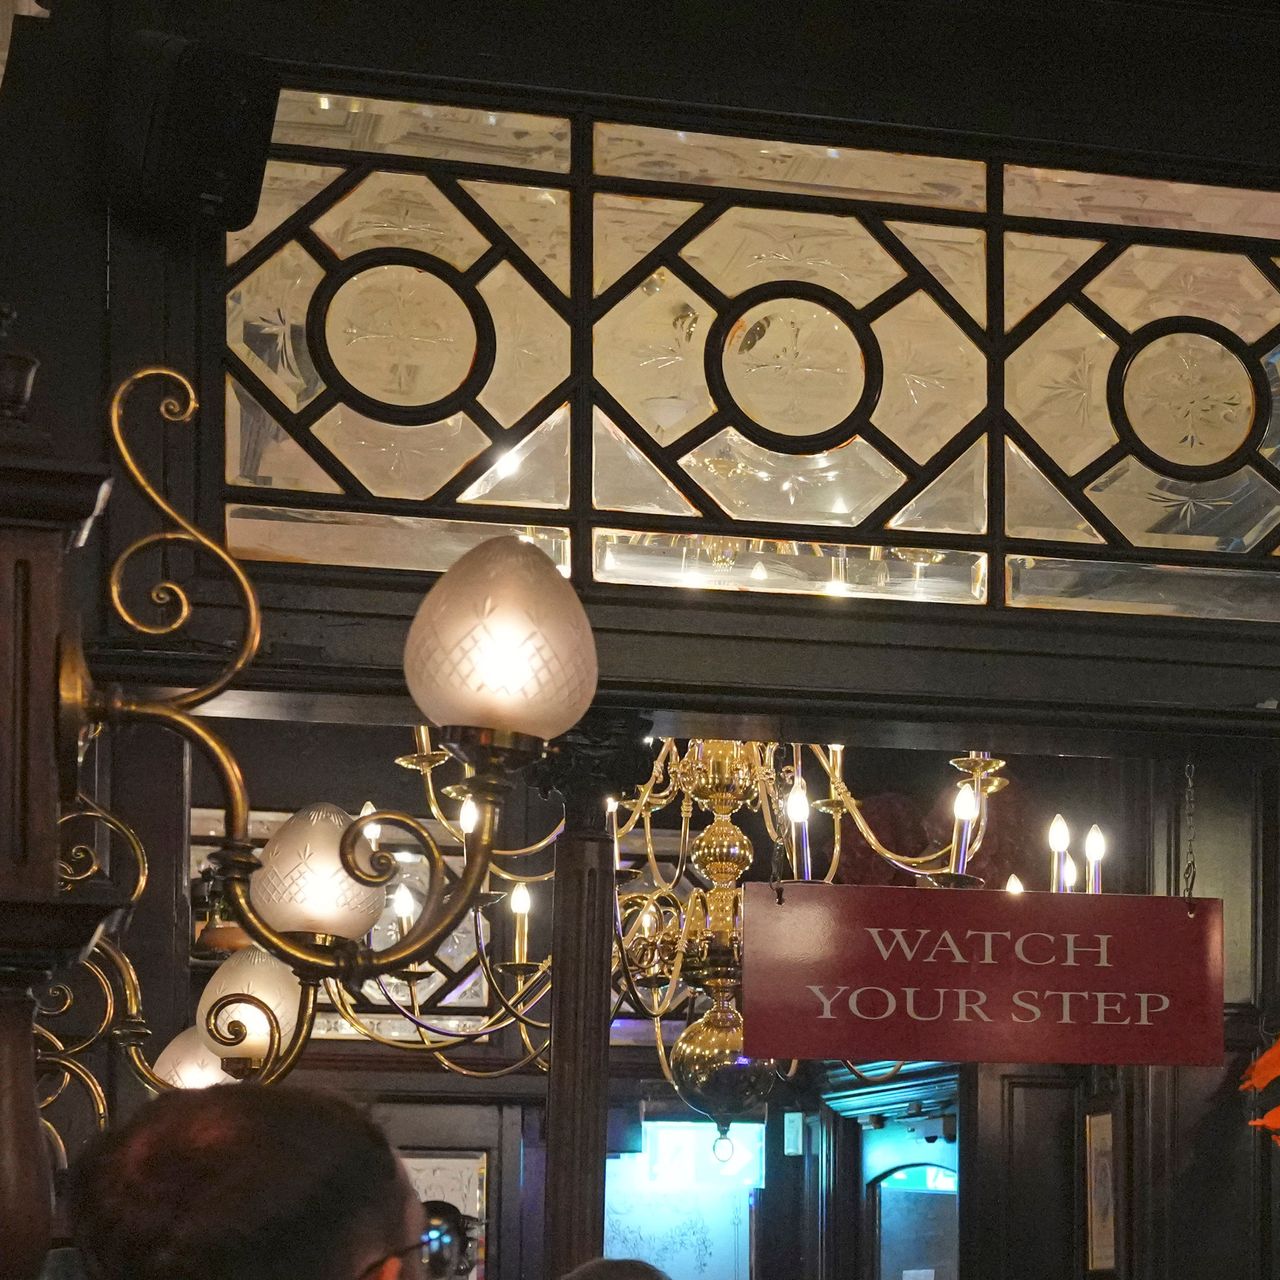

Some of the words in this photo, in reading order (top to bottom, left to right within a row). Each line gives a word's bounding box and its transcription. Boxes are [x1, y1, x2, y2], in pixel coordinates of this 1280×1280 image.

[866, 928, 1114, 967] WATCH
[806, 984, 993, 1022] YOUR
[1011, 990, 1170, 1026] STEP
